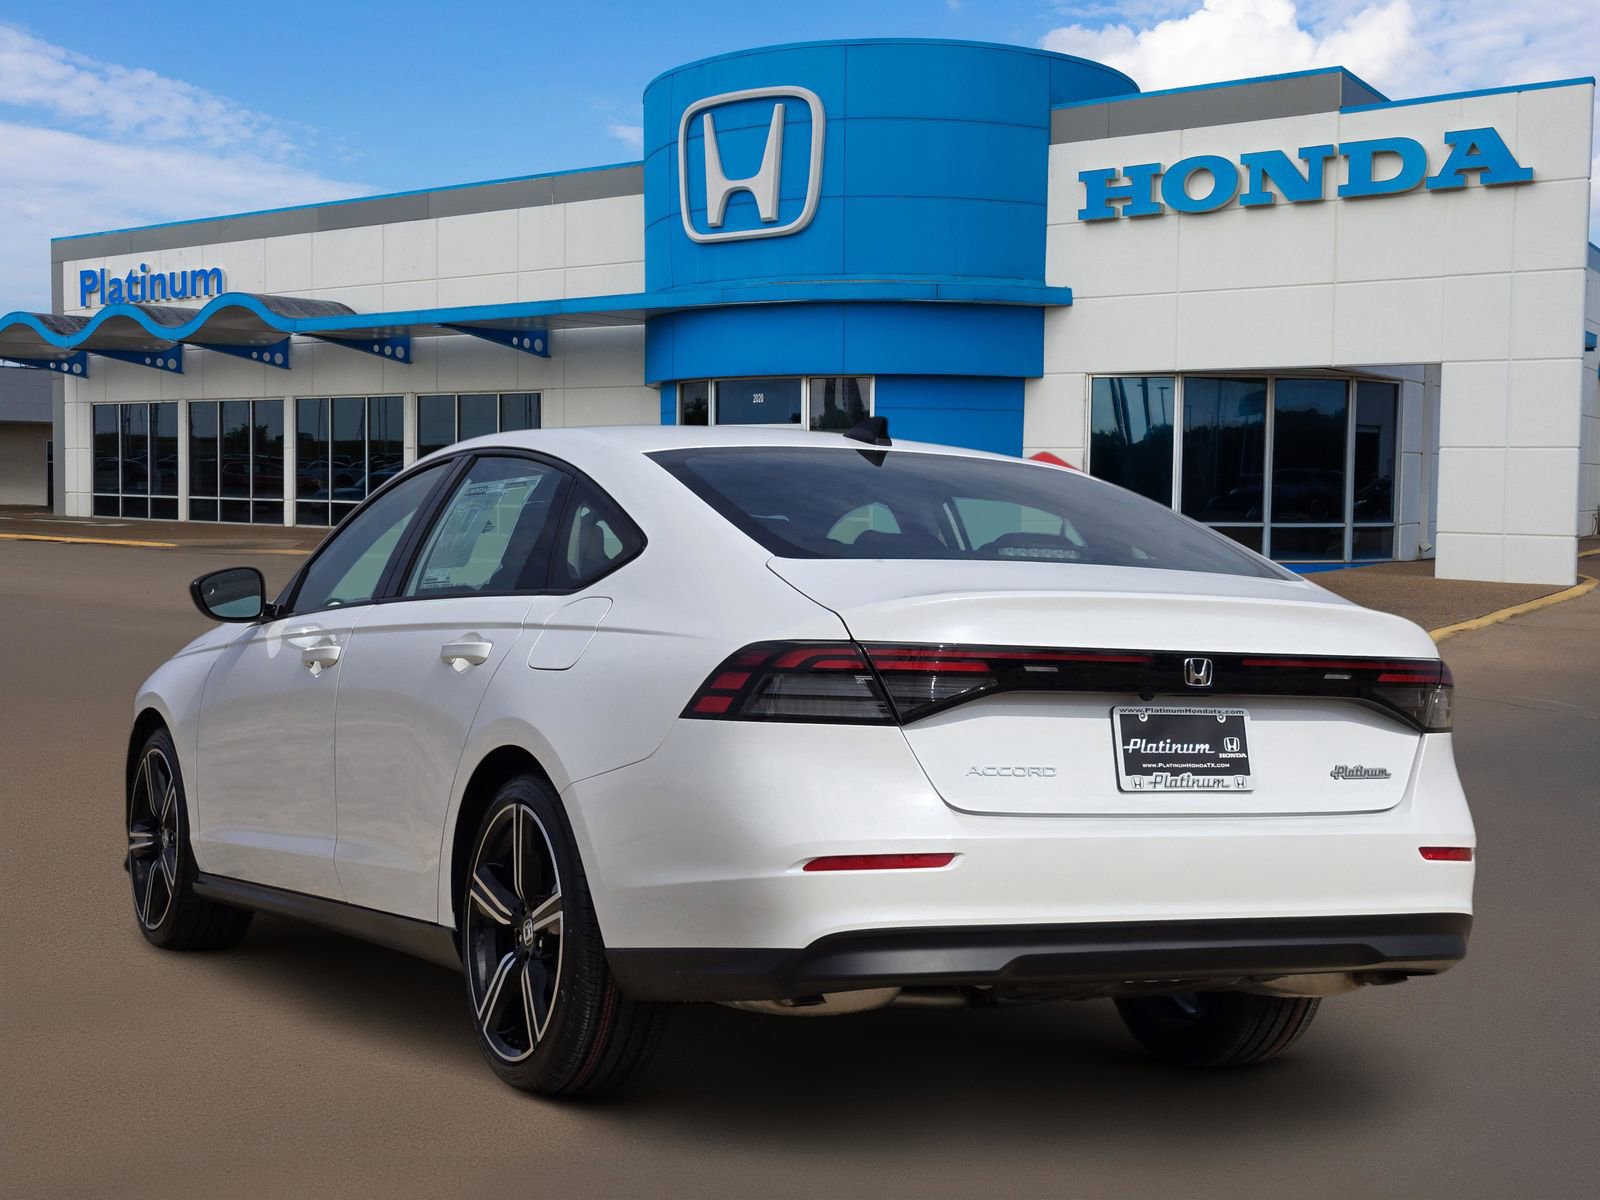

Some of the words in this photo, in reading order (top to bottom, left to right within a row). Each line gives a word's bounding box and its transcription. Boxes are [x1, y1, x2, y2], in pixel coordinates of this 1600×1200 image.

[1077, 126, 1535, 223] HONDA
[79, 263, 226, 308] Platinum
[1123, 738, 1216, 754] Platinum
[964, 765, 1057, 778] ACCORD
[1329, 764, 1393, 781] Platinum
[1148, 773, 1232, 790] Platinum
